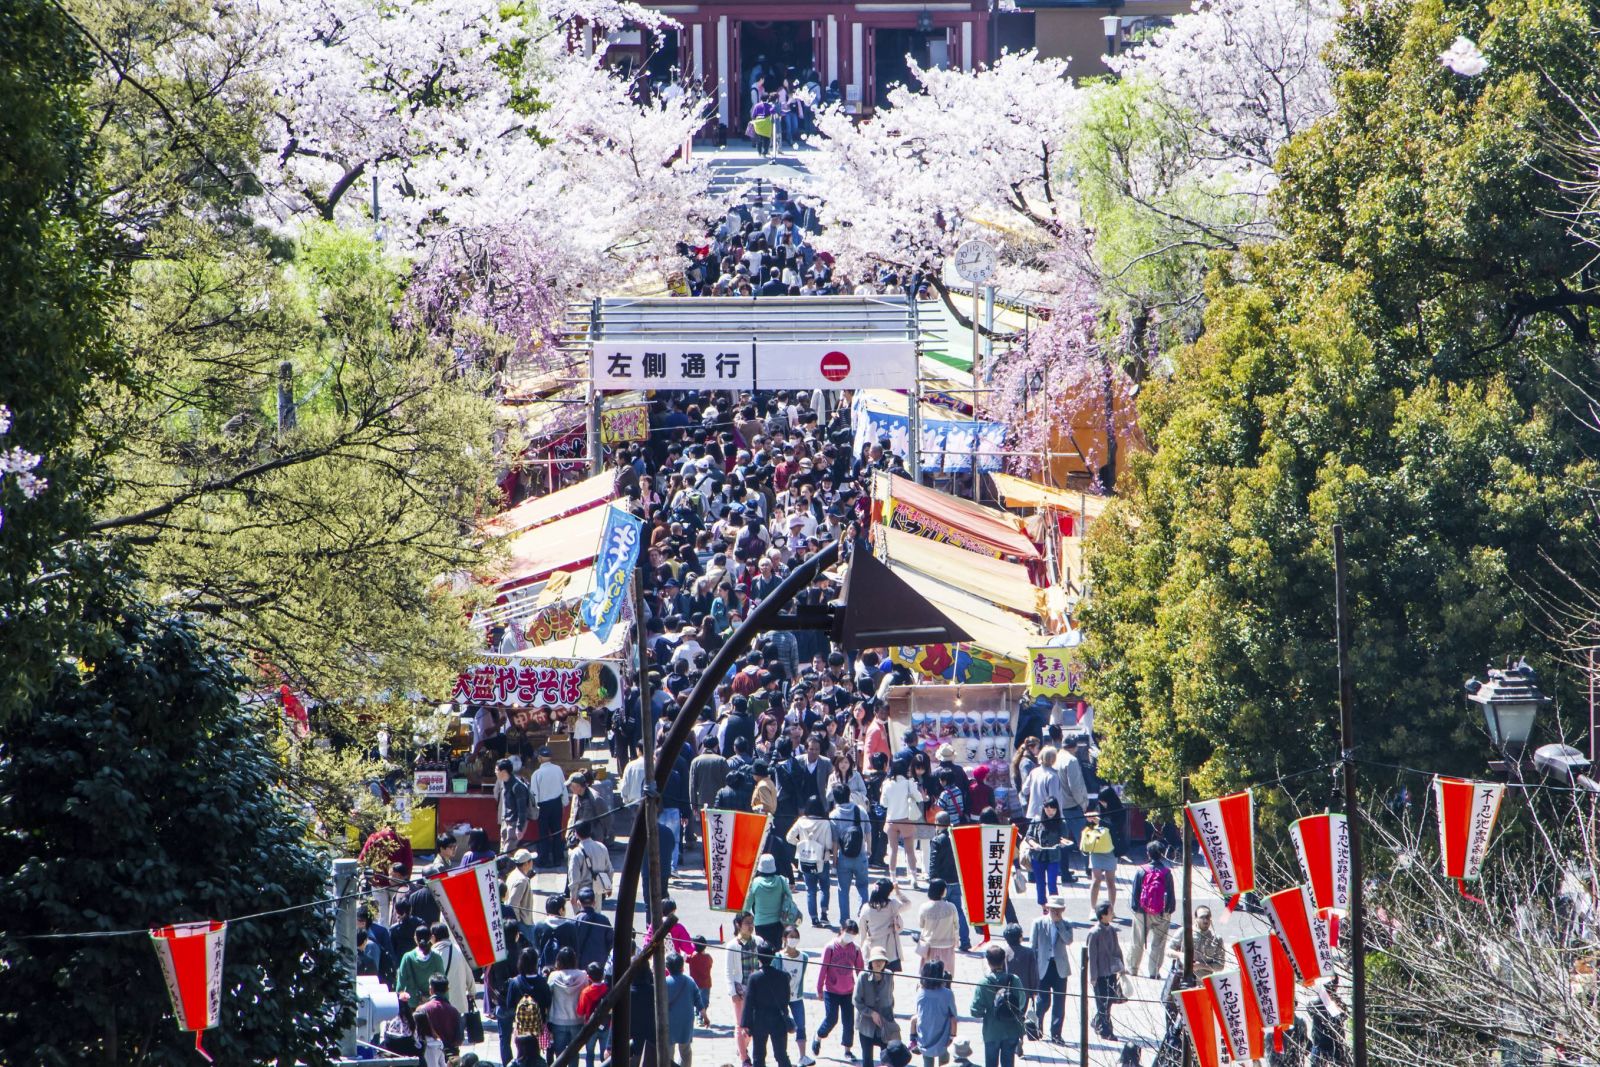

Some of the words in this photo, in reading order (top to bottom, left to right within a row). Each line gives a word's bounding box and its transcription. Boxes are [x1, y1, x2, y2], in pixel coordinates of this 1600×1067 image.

[607, 352, 741, 379] 左側通行
[452, 665, 583, 703] 大盛やきそば
[986, 829, 1005, 920] 上野大観光祭
